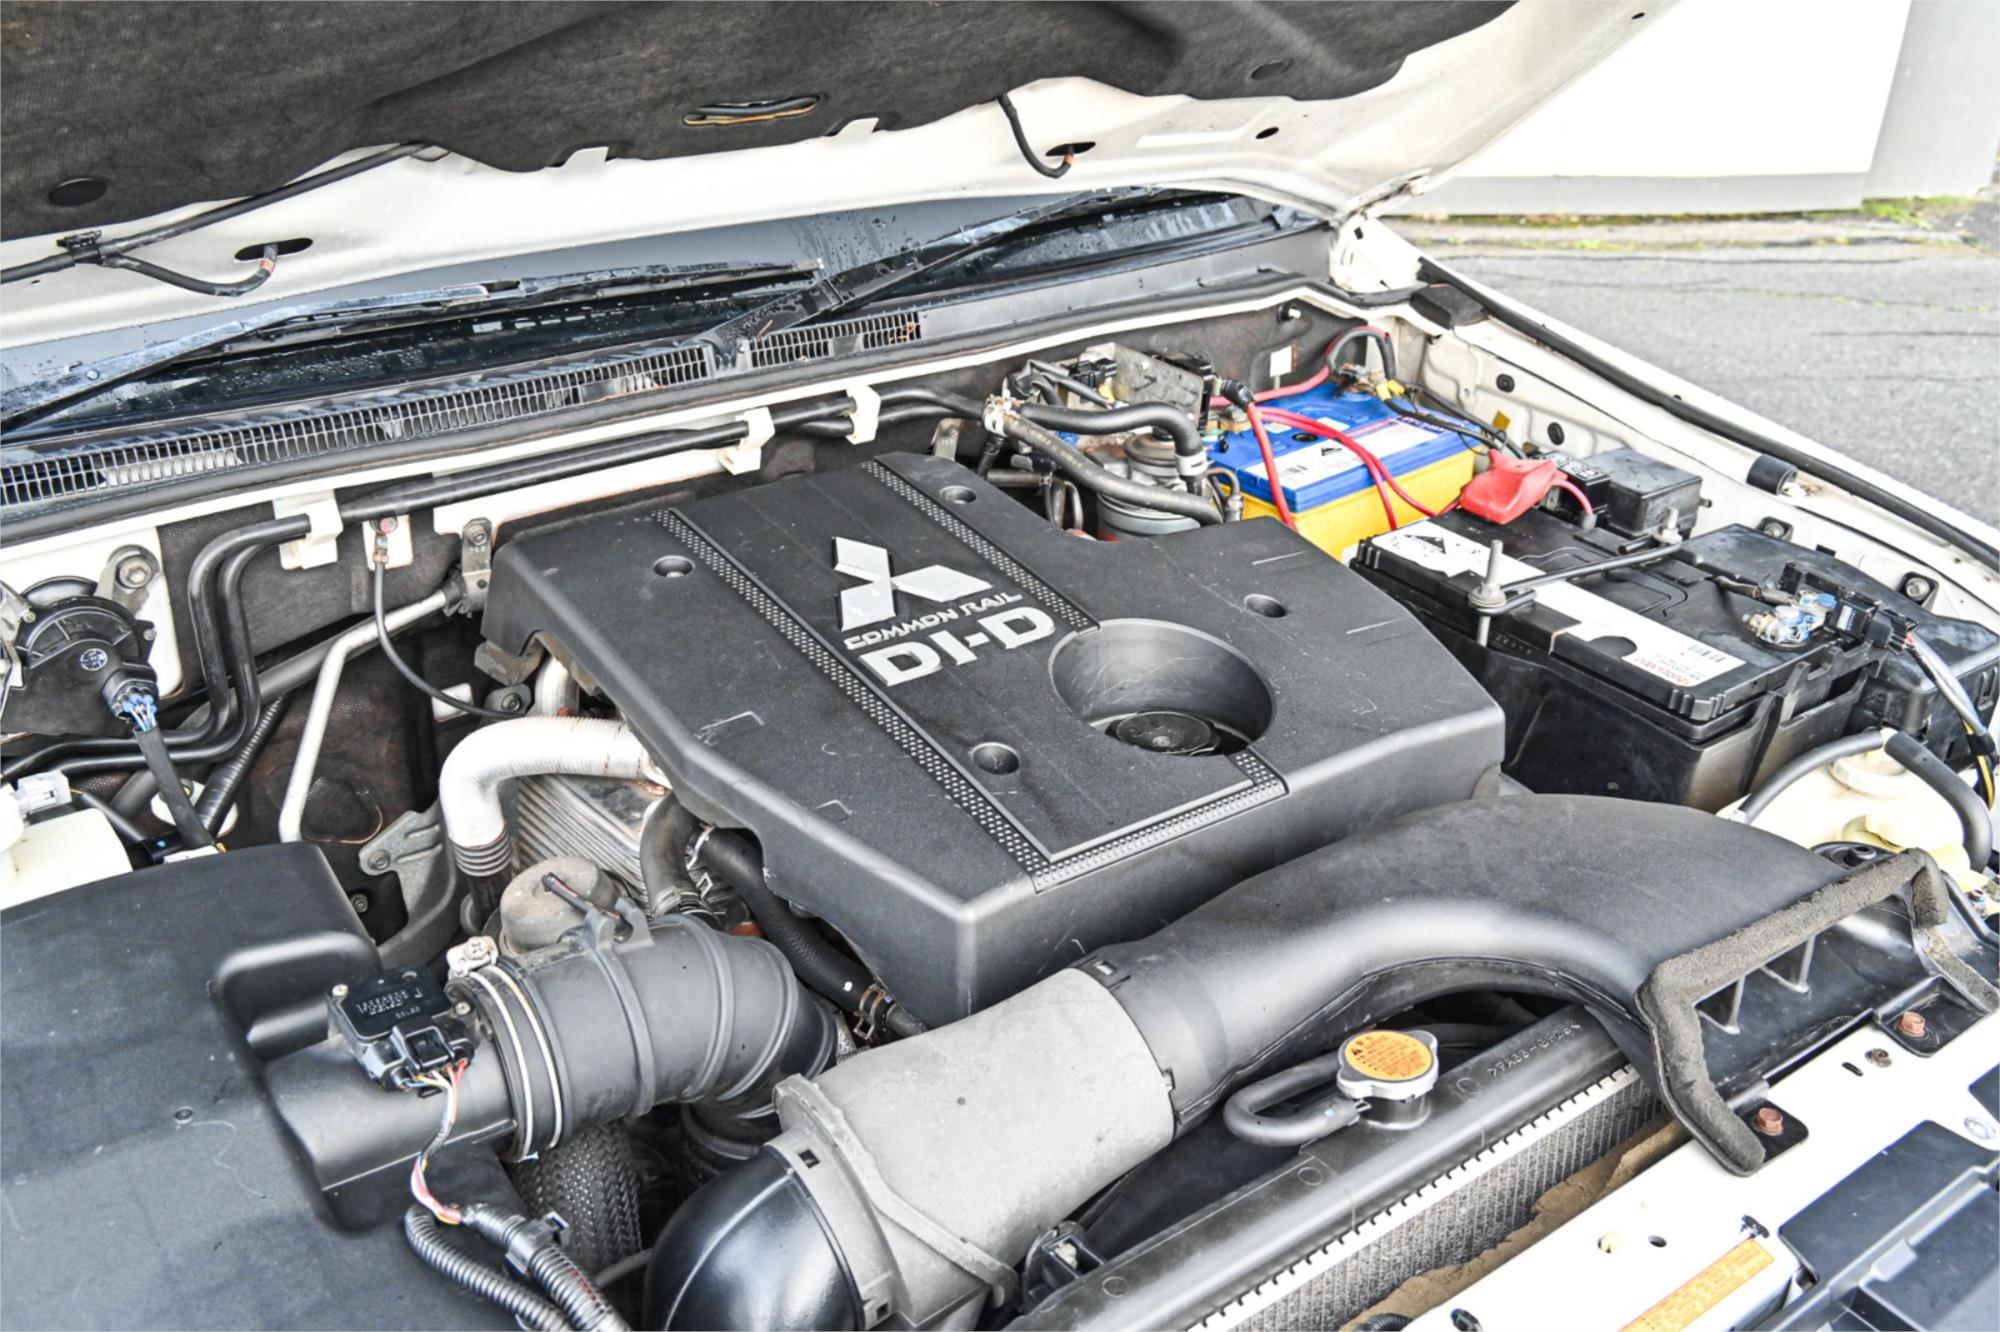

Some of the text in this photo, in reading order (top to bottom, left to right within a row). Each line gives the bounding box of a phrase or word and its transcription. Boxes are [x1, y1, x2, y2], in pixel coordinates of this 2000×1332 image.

[843, 592, 1024, 650] COMMON RAIL
[858, 606, 1056, 687] DI-D
